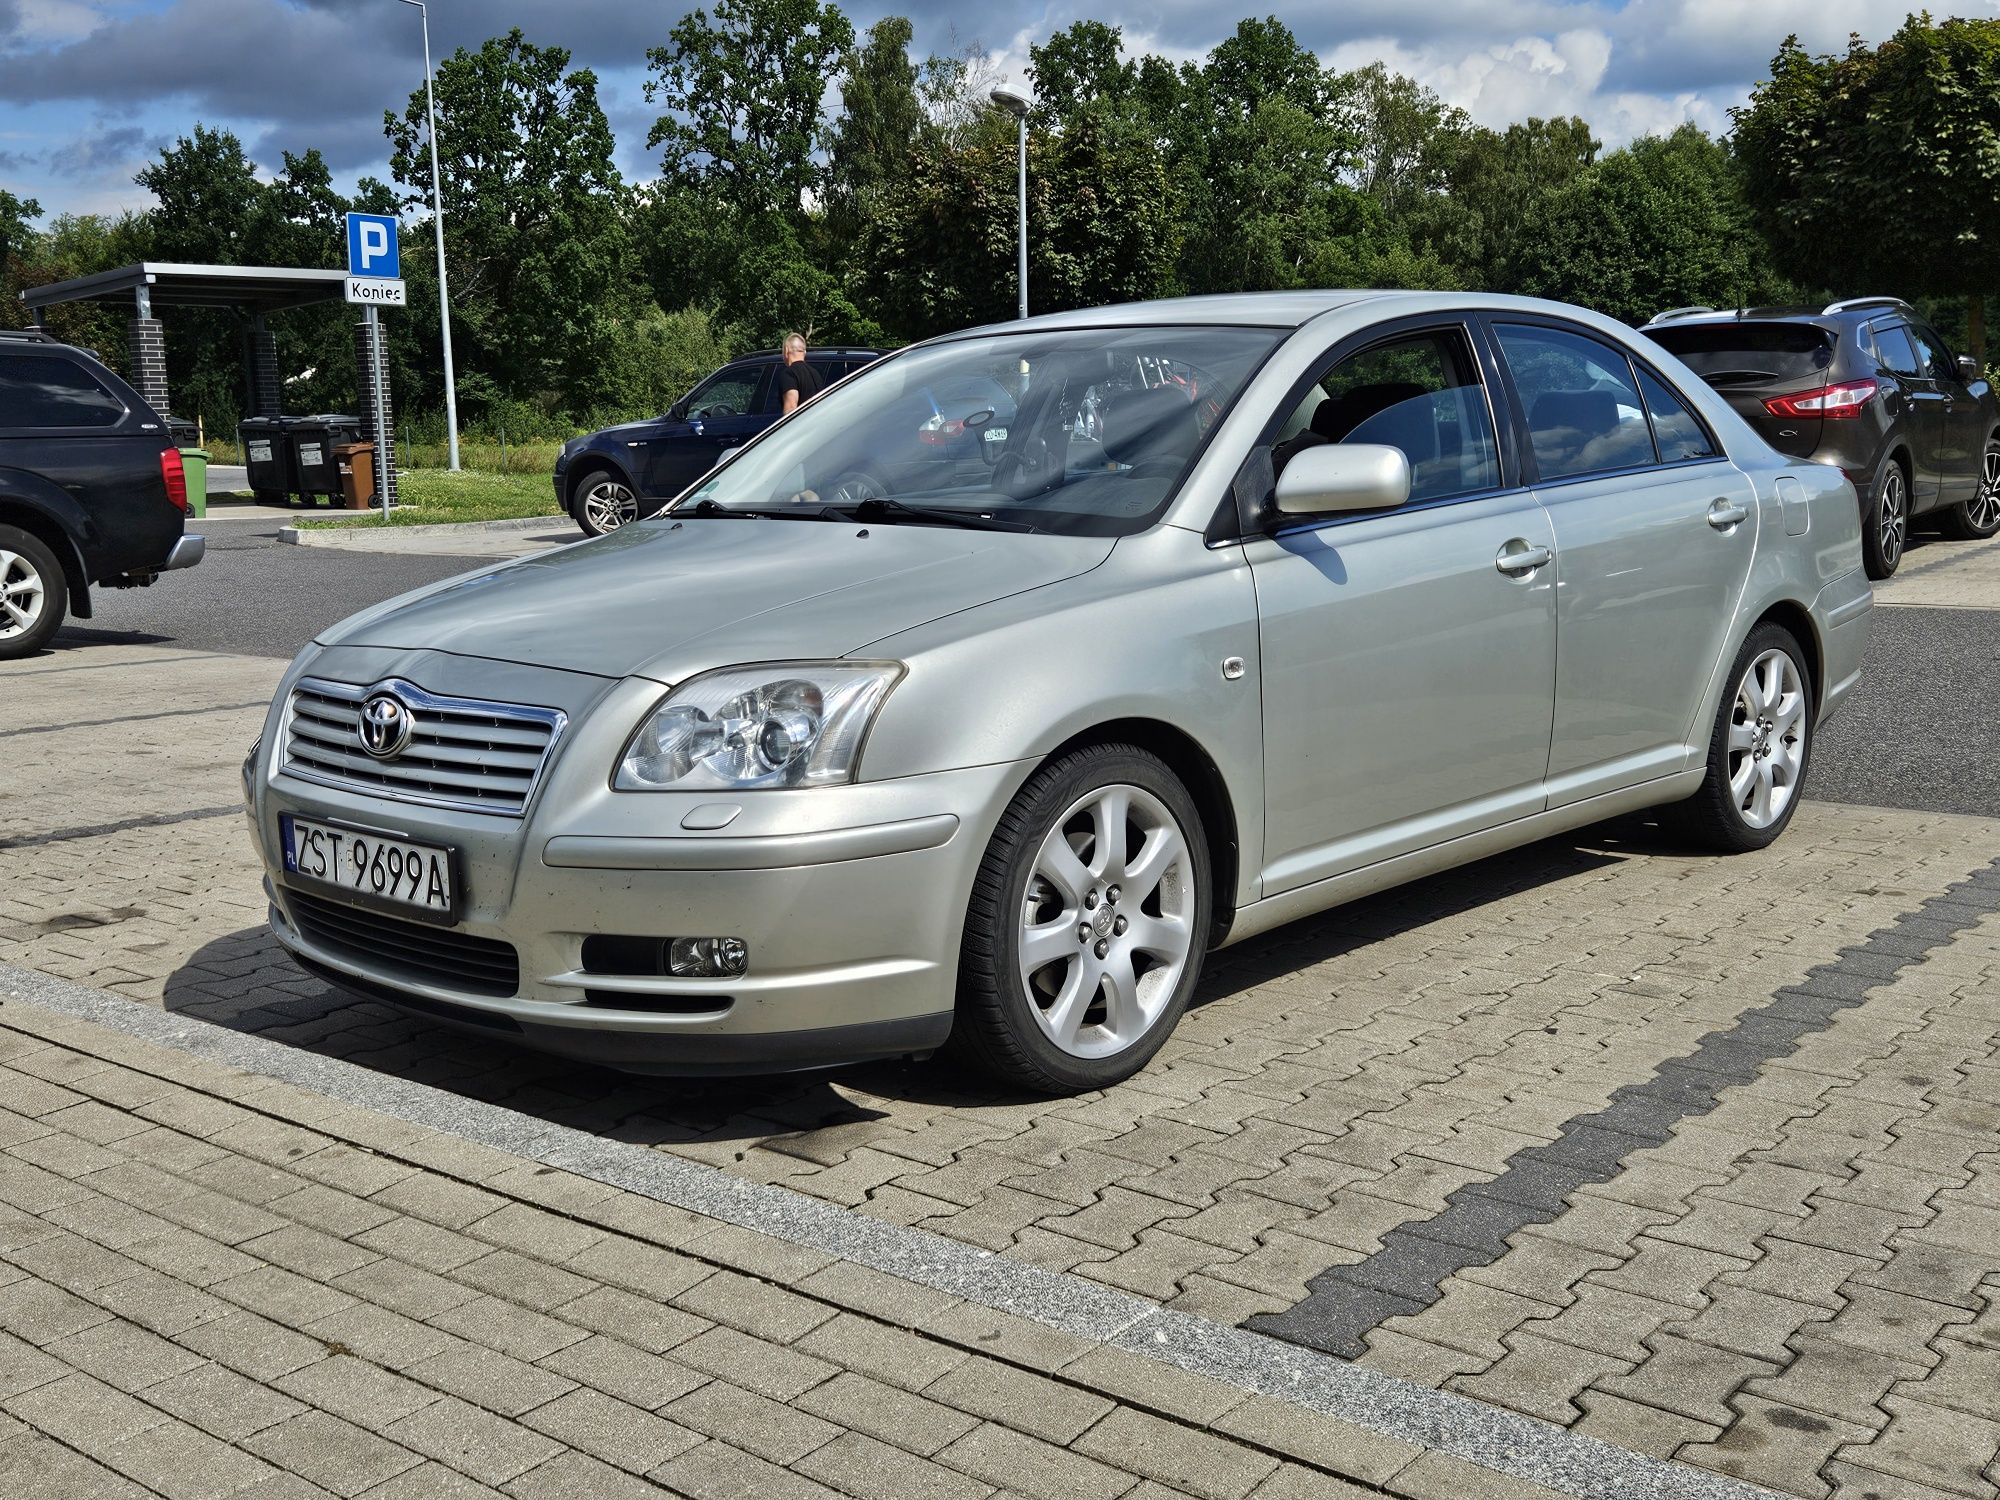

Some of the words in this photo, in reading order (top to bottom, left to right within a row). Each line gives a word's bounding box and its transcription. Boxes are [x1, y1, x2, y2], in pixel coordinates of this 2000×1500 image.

[360, 221, 388, 269] P
[352, 282, 401, 300] Koniec
[287, 851, 296, 865] PL
[295, 824, 343, 883] ZST
[353, 839, 447, 907] 9699A
